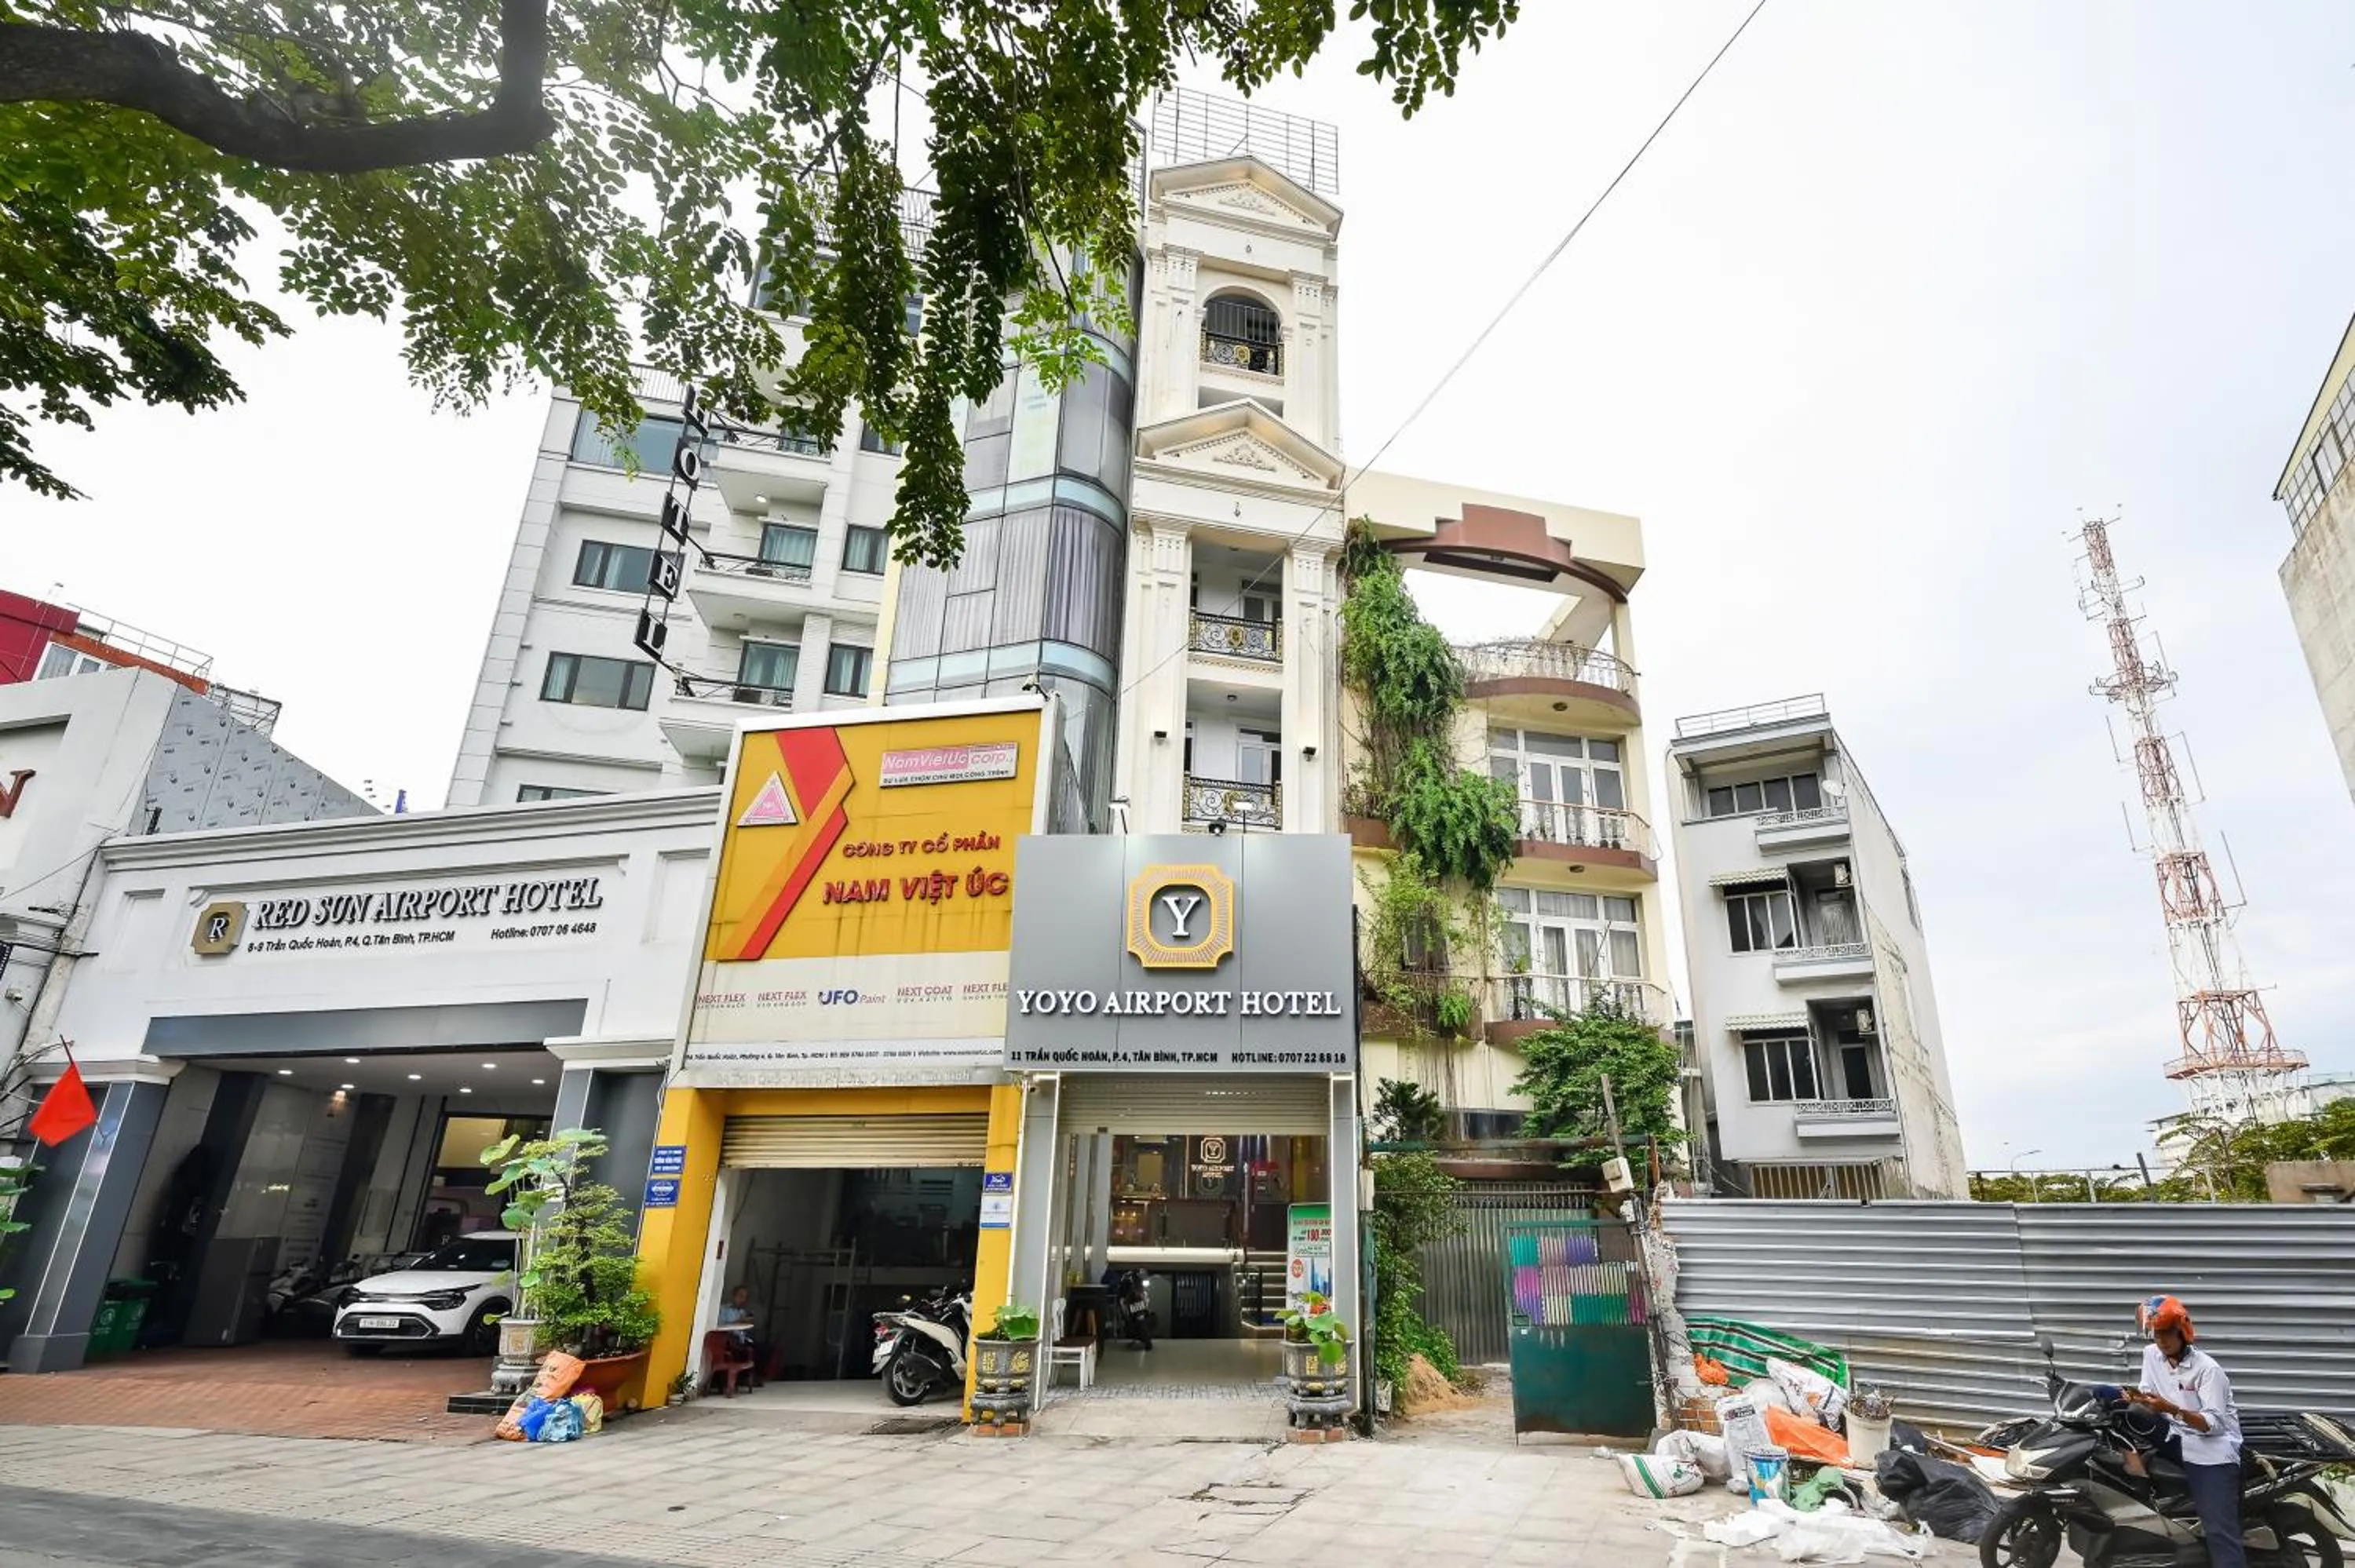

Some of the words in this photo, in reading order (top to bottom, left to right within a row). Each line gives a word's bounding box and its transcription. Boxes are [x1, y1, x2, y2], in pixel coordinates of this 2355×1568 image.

[641, 383, 709, 659] HOTEL
[899, 841, 918, 855] TY
[823, 878, 891, 905] NAM
[900, 869, 958, 905] VIỆT
[965, 866, 1010, 898] ÚC
[252, 899, 311, 932] RED
[312, 892, 373, 927] SUN
[371, 884, 500, 924] AIRPORT
[499, 877, 603, 915] HOTEL
[1162, 896, 1201, 937] Y
[209, 917, 226, 938] R
[758, 992, 783, 1001] NEXT
[897, 987, 922, 997] NEXT
[963, 984, 989, 994] NEXT
[991, 983, 1009, 992] FLE
[817, 990, 859, 1005] UFO
[1017, 990, 1097, 1015] YOYO
[1101, 991, 1232, 1016] AIRPORT
[1240, 991, 1342, 1016] HOTEL
[1052, 1047, 1079, 1063] QUỐC
[1181, 1052, 1218, 1063] TP.HCM
[1304, 1052, 1317, 1063] 22
